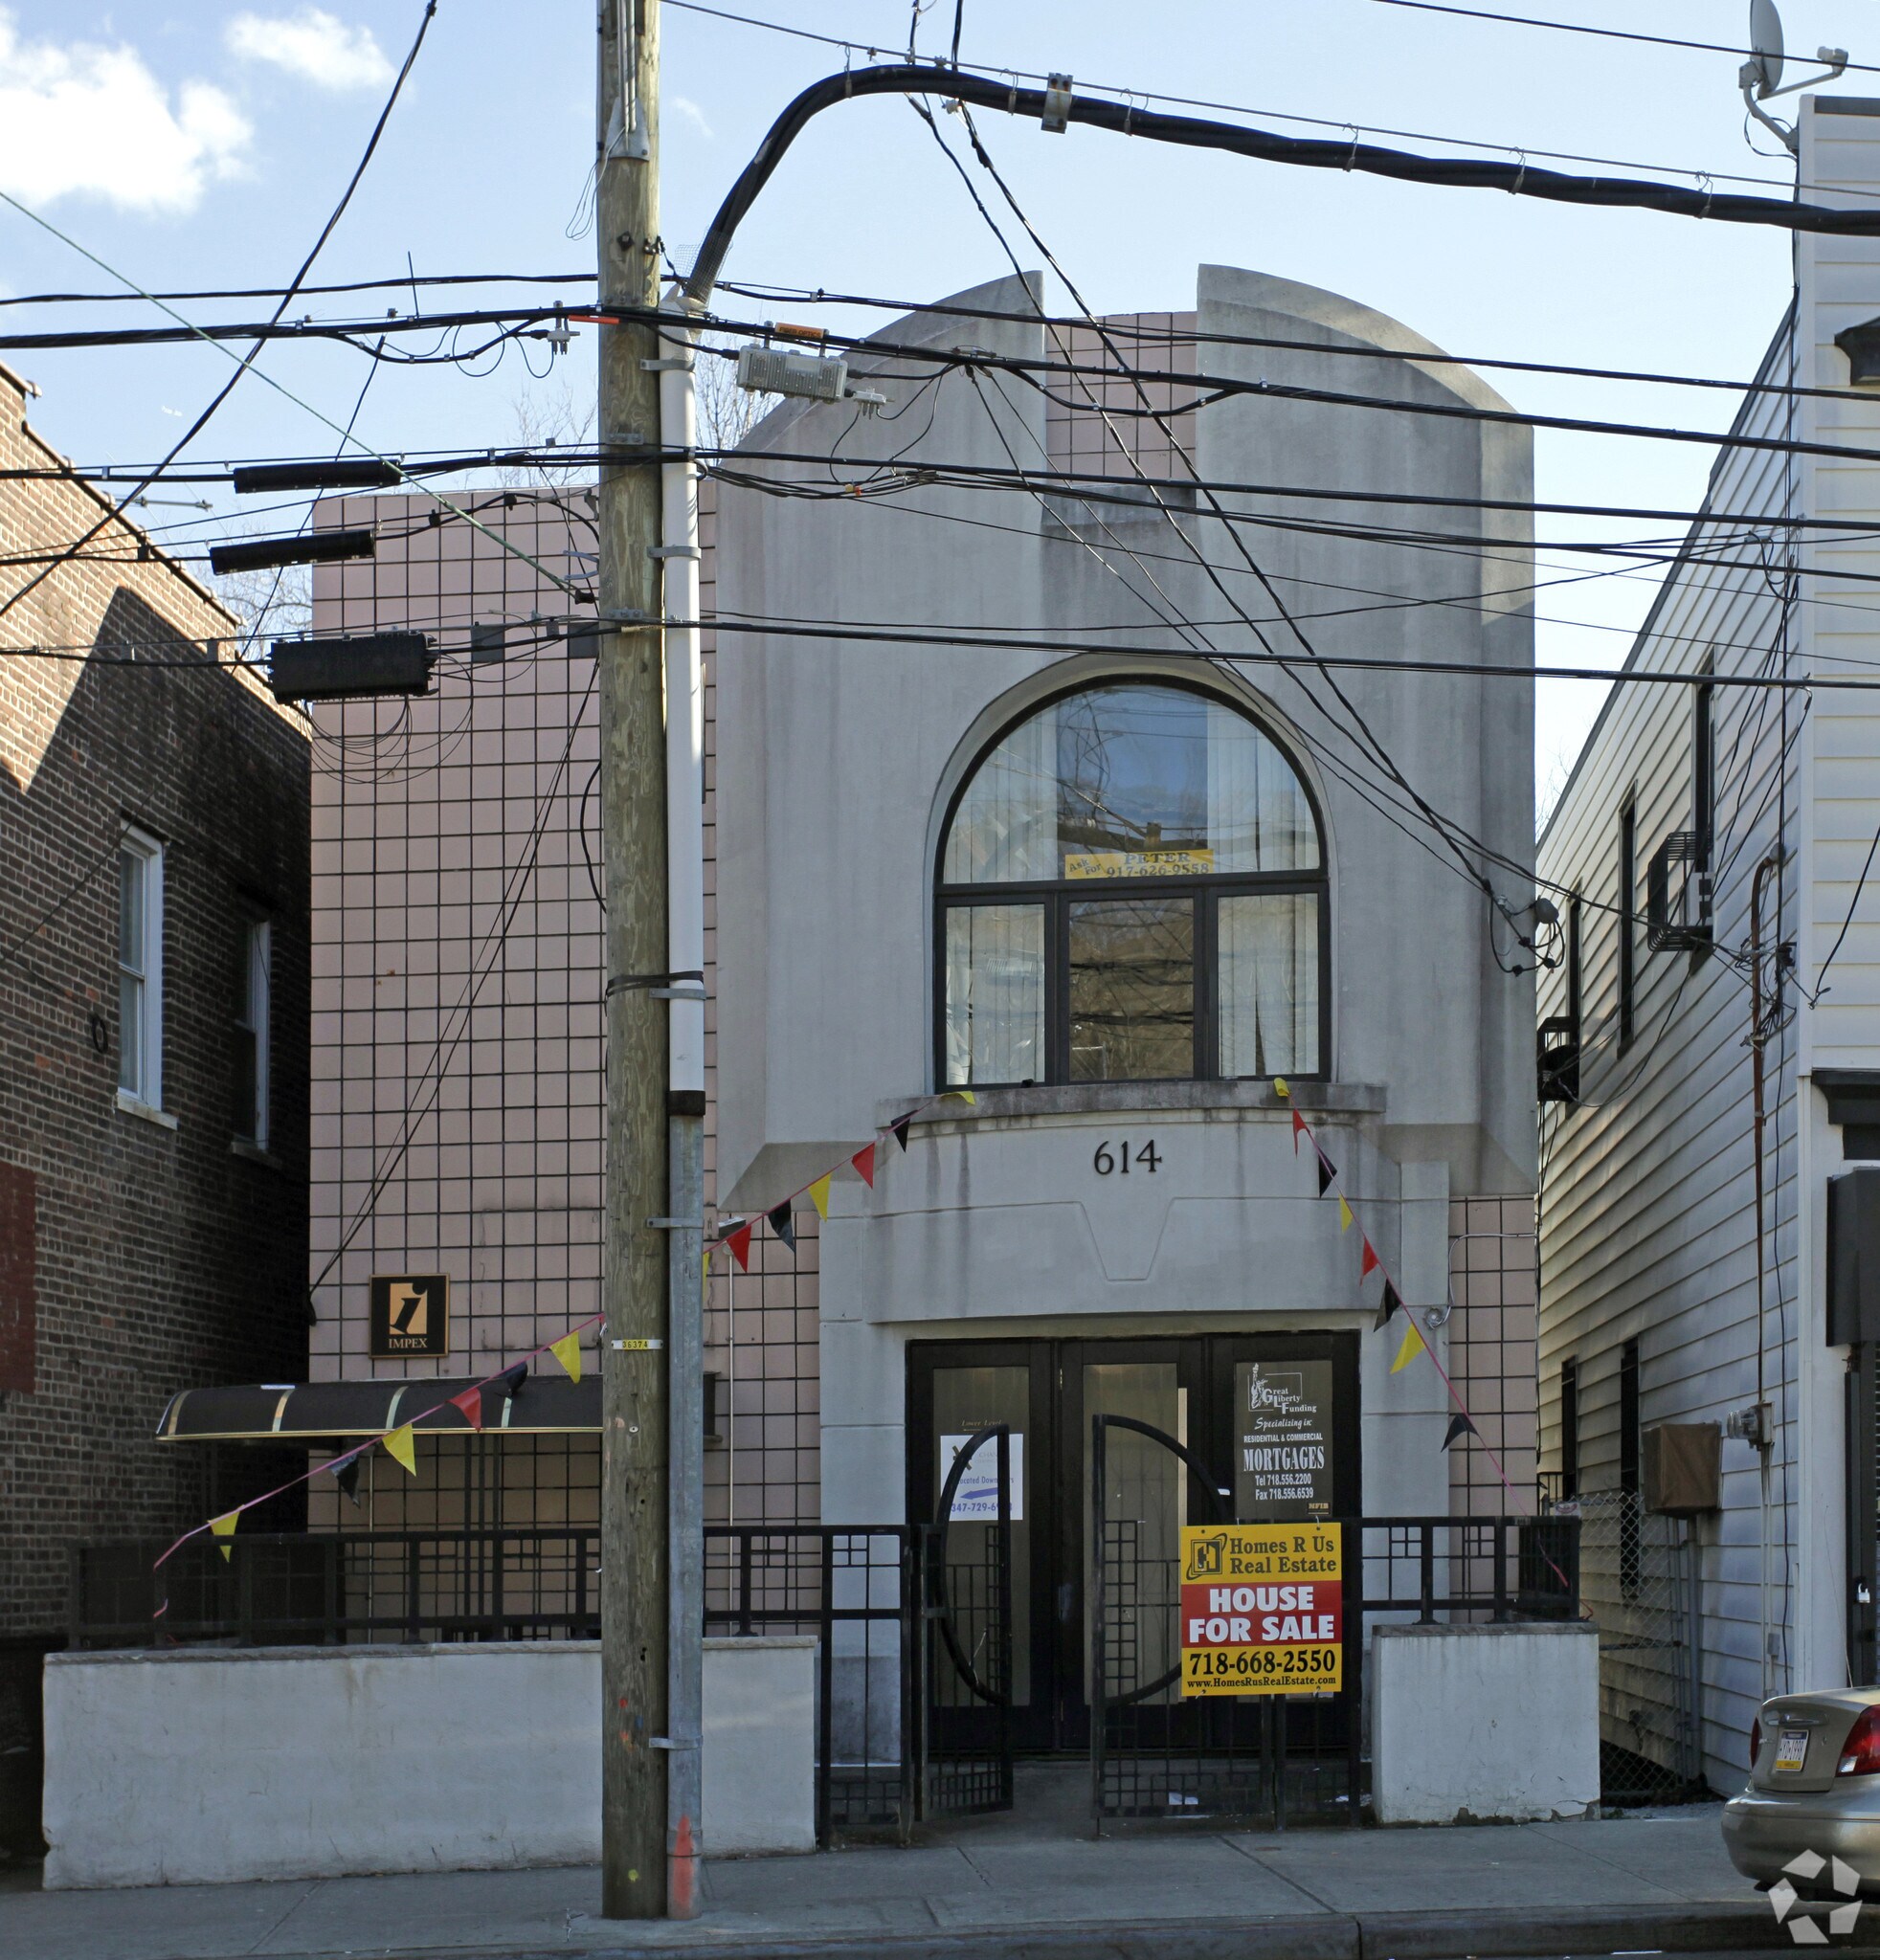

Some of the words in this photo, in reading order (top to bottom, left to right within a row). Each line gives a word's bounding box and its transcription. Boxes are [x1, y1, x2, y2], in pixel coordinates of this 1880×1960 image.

[1124, 852, 1191, 864] PETER
[1068, 858, 1089, 872] Ask
[1085, 863, 1102, 875] For
[1107, 863, 1209, 878] 917-626-9558
[1093, 1139, 1163, 1175] 614
[388, 1337, 428, 1349] IMPEX
[1263, 1387, 1288, 1404] Great
[1273, 1394, 1300, 1408] Liberty
[1282, 1402, 1317, 1414] Funding
[1254, 1417, 1302, 1432] Specializing
[1243, 1434, 1280, 1443] RESIDENTIAL
[1286, 1432, 1323, 1441] COMMERCIAL
[1242, 1445, 1325, 1471] MORTGAGES
[959, 1476, 980, 1484] ocated
[1255, 1475, 1265, 1486] Tel
[1267, 1473, 1311, 1485] 718.556.2200
[1255, 1489, 1268, 1501] Fax
[1269, 1487, 1313, 1500] 718.556.6539
[1230, 1537, 1287, 1554] Homes
[1293, 1536, 1307, 1553] R
[1312, 1535, 1334, 1552] Us
[1230, 1557, 1271, 1574] Real
[1278, 1556, 1336, 1572] Estate
[1209, 1586, 1314, 1613] HOUSE
[1189, 1616, 1252, 1643] FOR
[1262, 1615, 1334, 1641] SALE
[1190, 1649, 1335, 1675] 718-668-2550
[1187, 1676, 1336, 1688] www.HomesRusRealEstate.com
